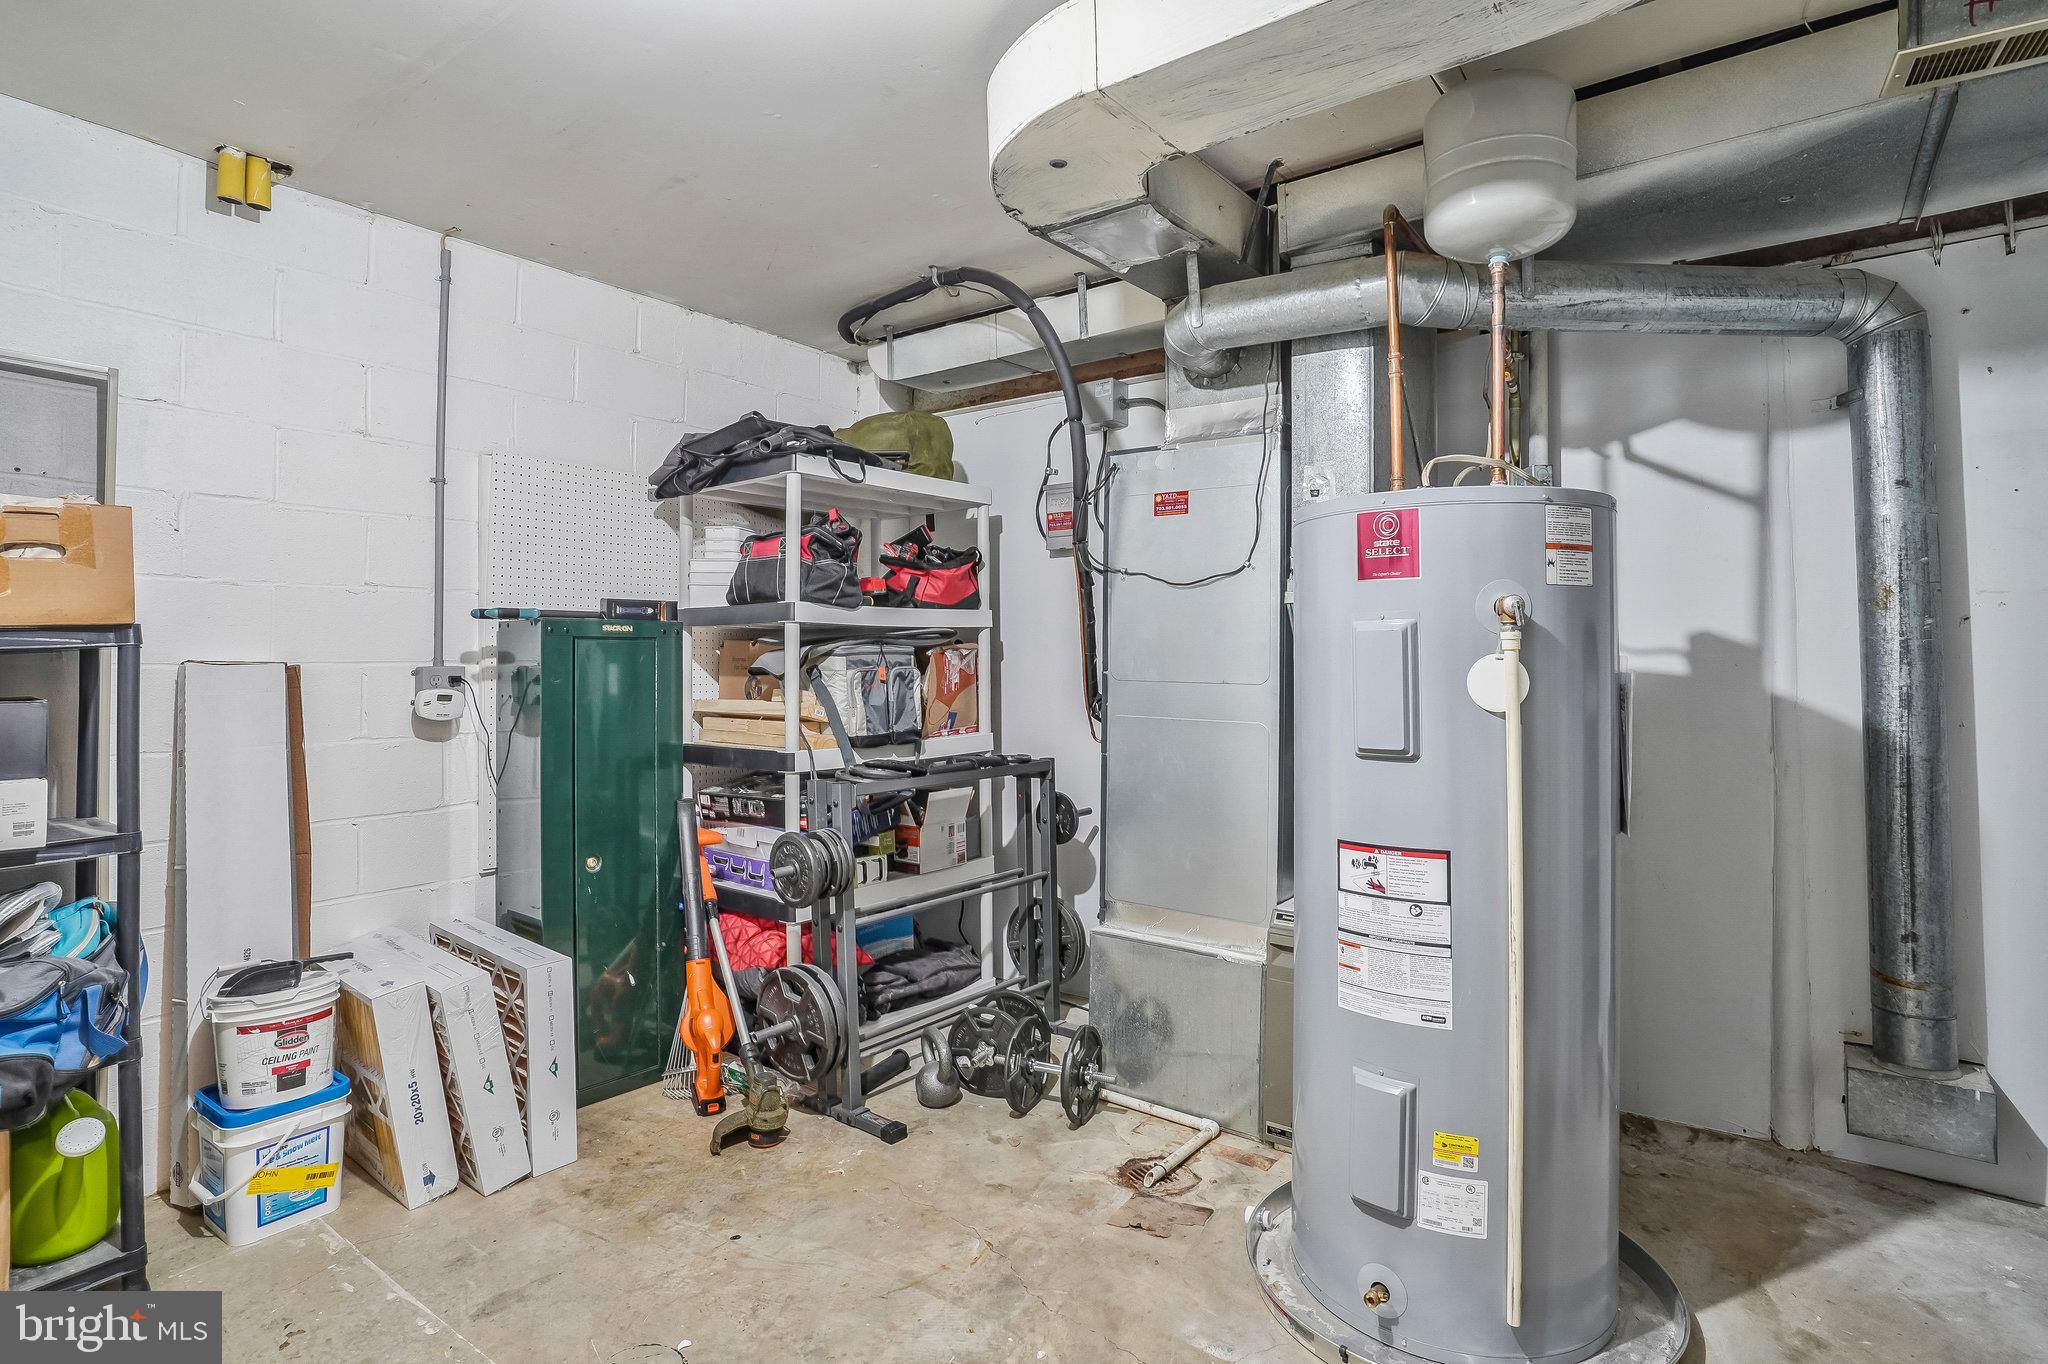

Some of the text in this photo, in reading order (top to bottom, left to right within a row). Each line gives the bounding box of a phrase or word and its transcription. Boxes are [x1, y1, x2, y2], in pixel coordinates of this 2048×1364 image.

[1365, 547, 1409, 557] SELECT
[274, 1034, 310, 1048] Glidden
[262, 1045, 320, 1066] CEILING PAINT
[408, 1081, 424, 1126] 20x20x5
